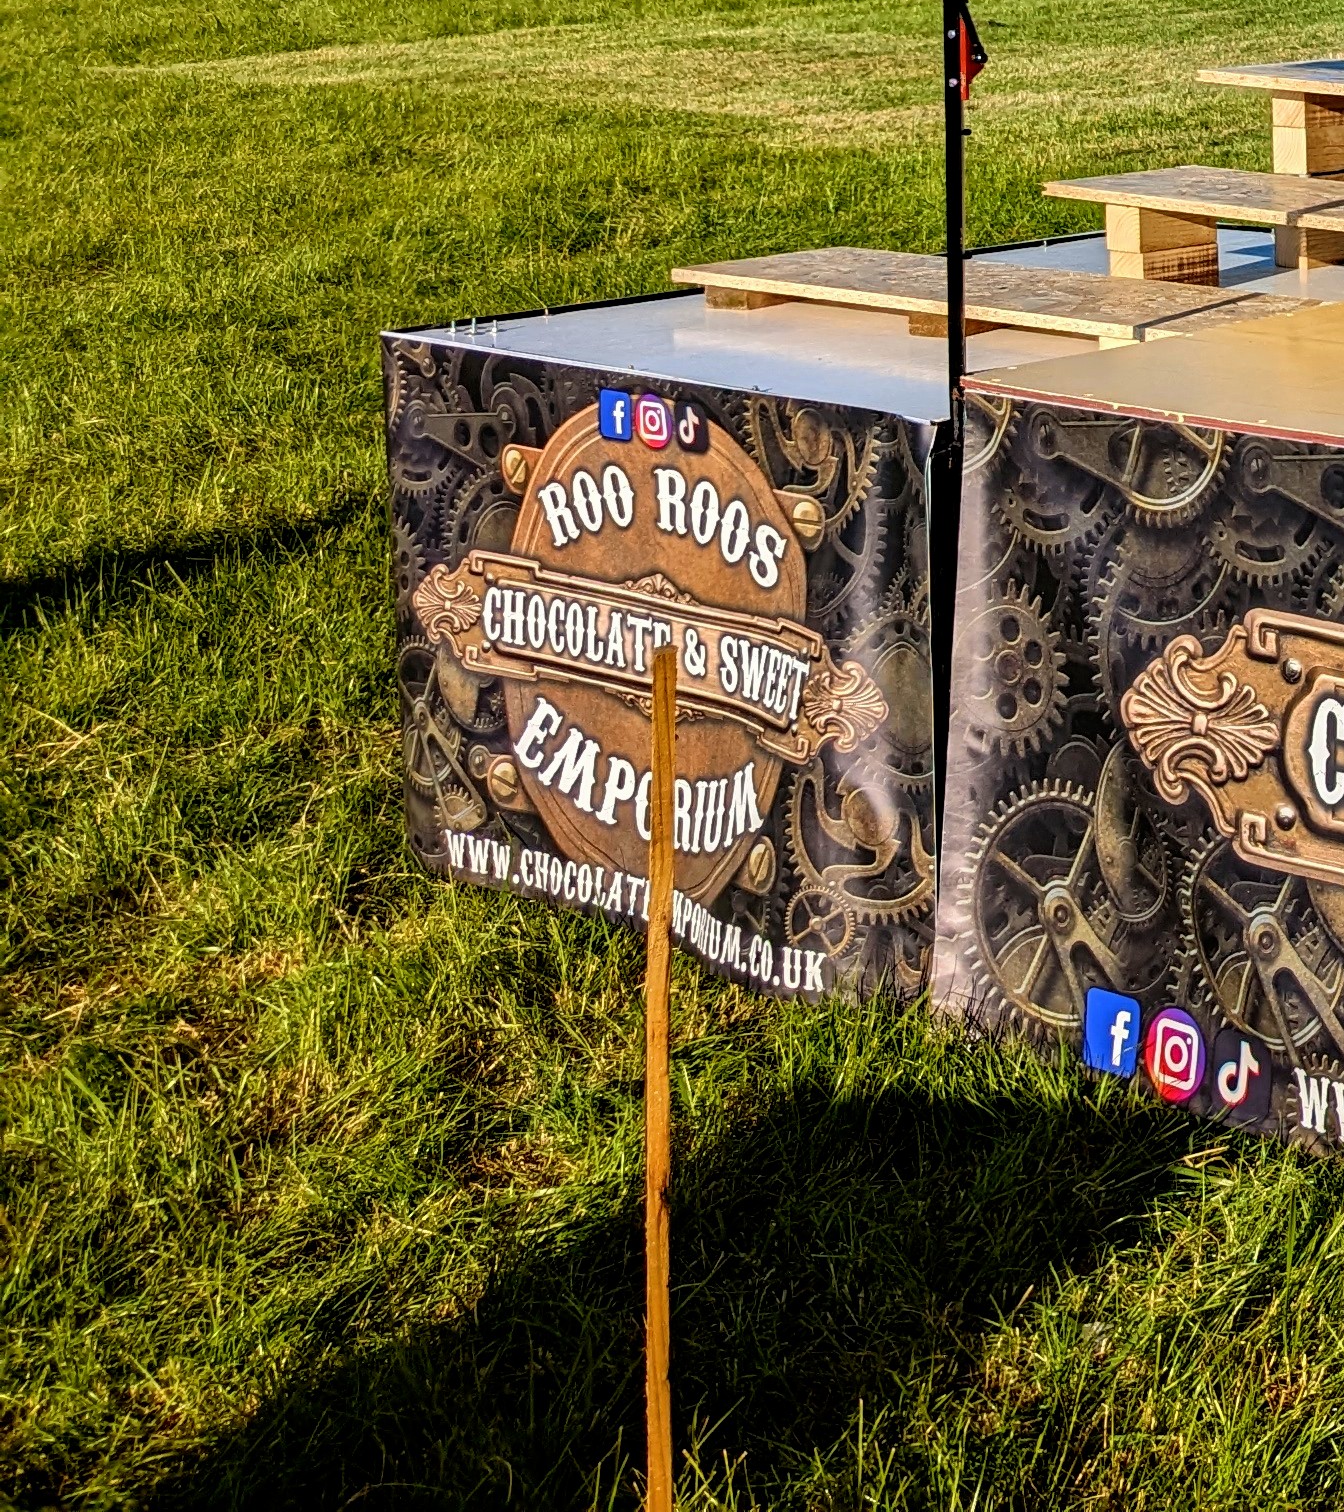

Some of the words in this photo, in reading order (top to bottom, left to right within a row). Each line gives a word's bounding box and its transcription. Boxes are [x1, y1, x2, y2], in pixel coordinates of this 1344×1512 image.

[538, 464, 636, 548] ROO
[654, 468, 788, 588] ROOS
[684, 627, 706, 676] &
[720, 640, 810, 724] SWEET
[512, 696, 765, 856] EMPORIUM
[443, 828, 828, 993] WWW.CHOCOLATMPORIUM.CO.UK
